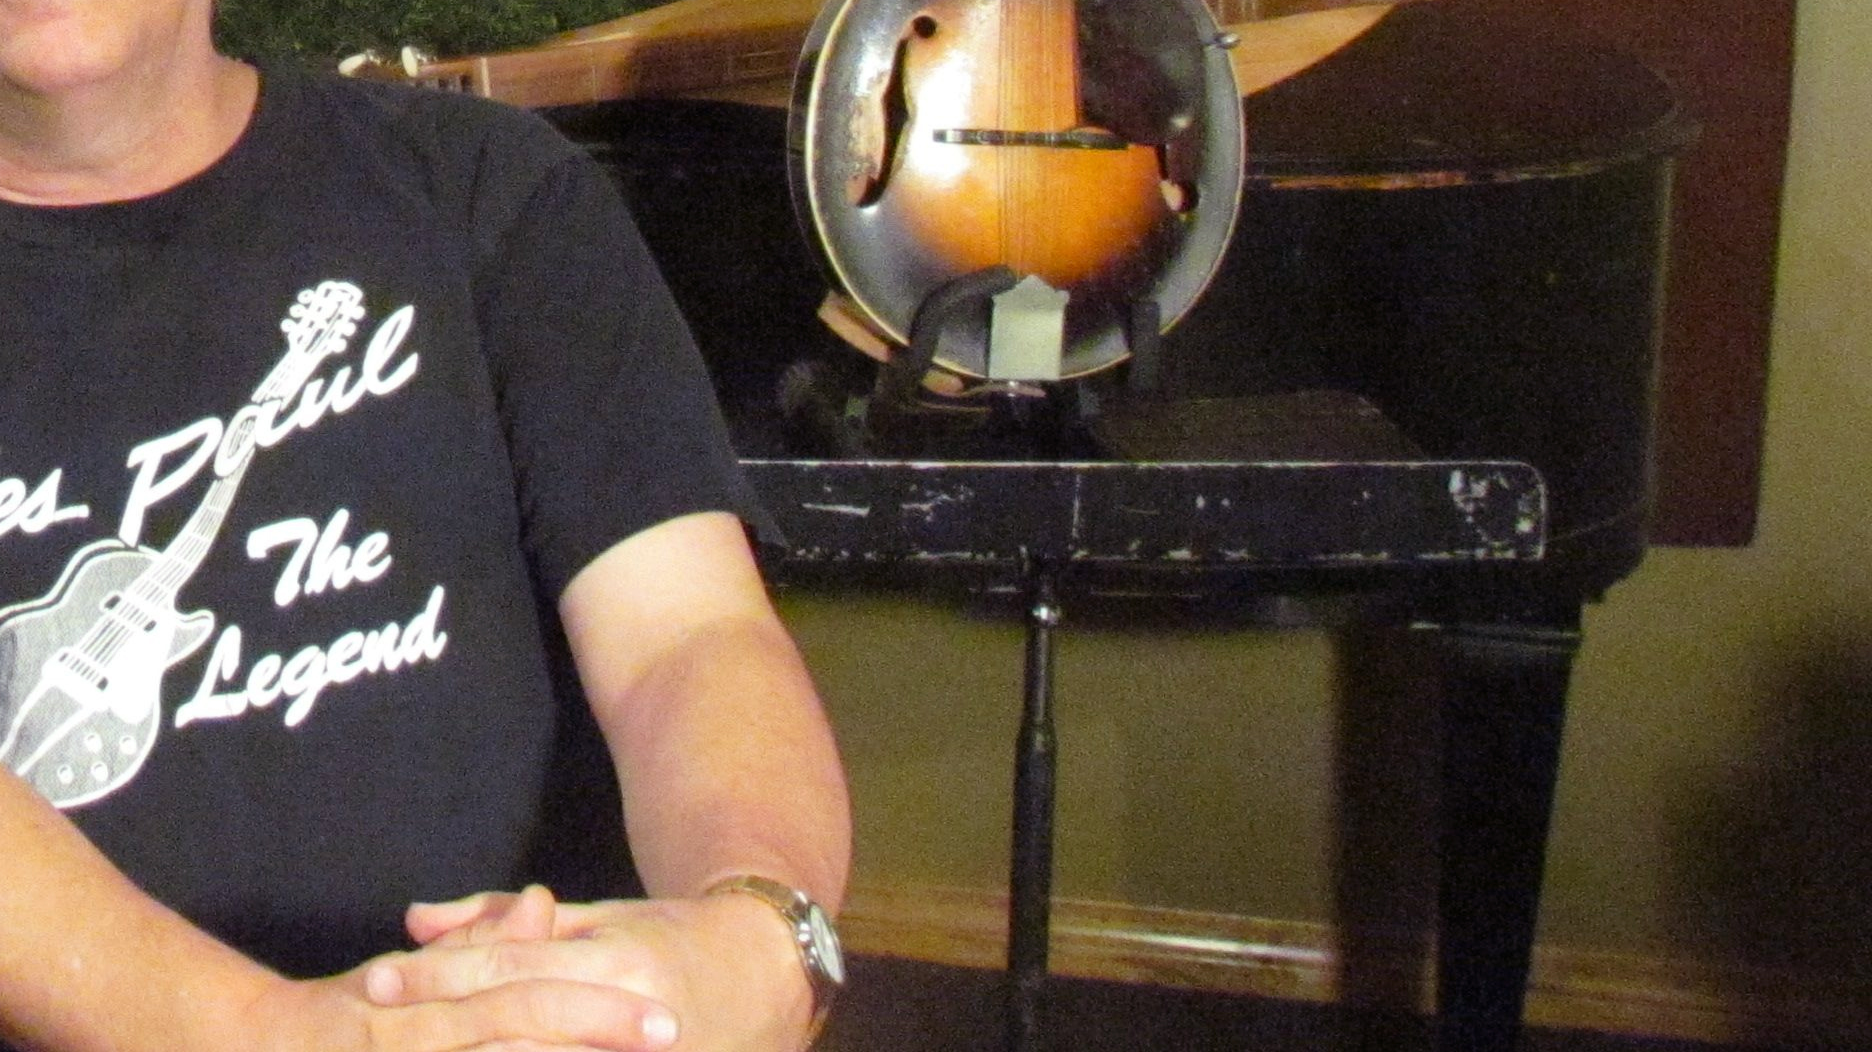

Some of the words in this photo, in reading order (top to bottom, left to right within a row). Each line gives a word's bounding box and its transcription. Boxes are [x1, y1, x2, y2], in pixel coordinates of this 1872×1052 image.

[118, 305, 419, 547] Paul
[246, 508, 392, 607] The
[175, 585, 447, 728] Legend
